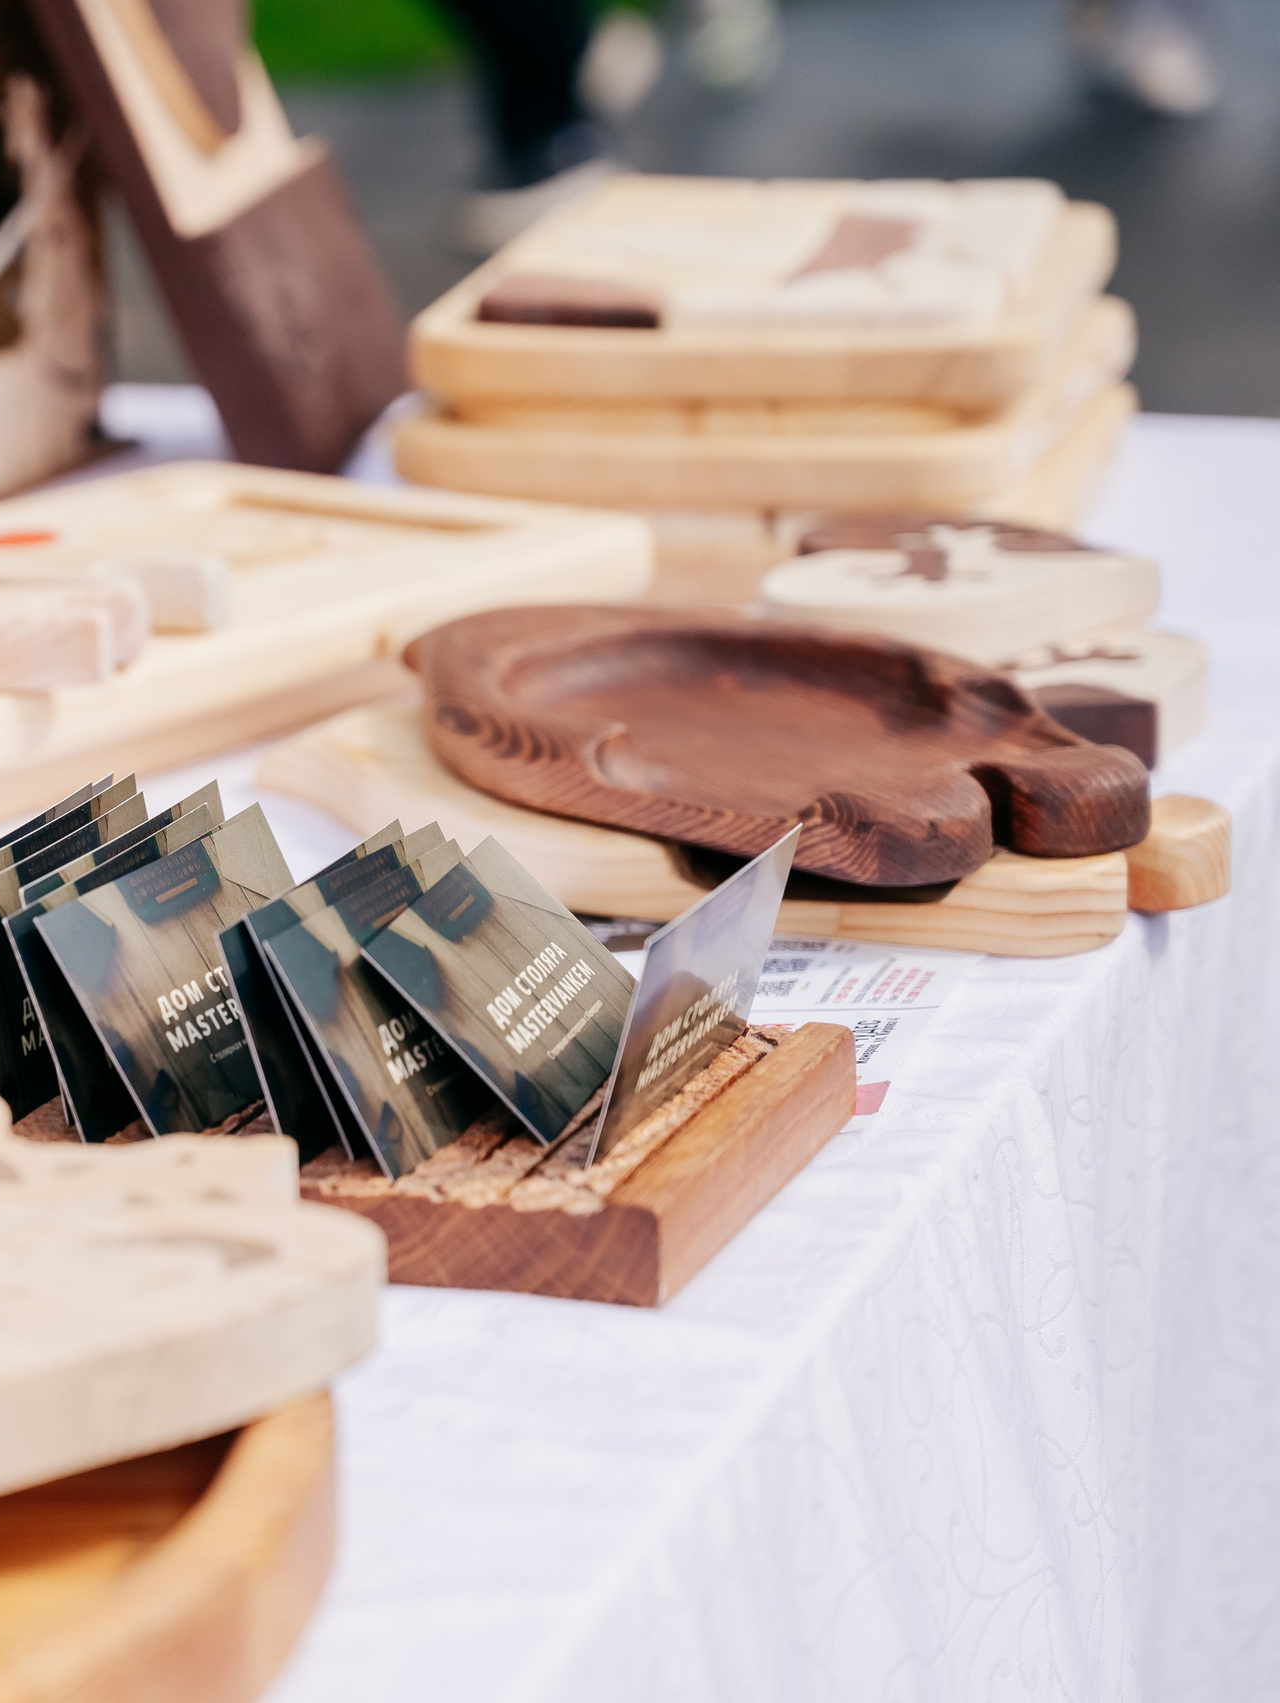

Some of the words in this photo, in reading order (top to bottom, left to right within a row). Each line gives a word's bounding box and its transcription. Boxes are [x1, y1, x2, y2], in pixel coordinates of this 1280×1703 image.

[157, 980, 205, 1026] ДОМ
[486, 986, 523, 1031] ДОМ
[515, 942, 567, 996] СТОЛЯРА
[505, 959, 595, 1055] MASTERVANKEM
[165, 998, 240, 1053] MASTER
